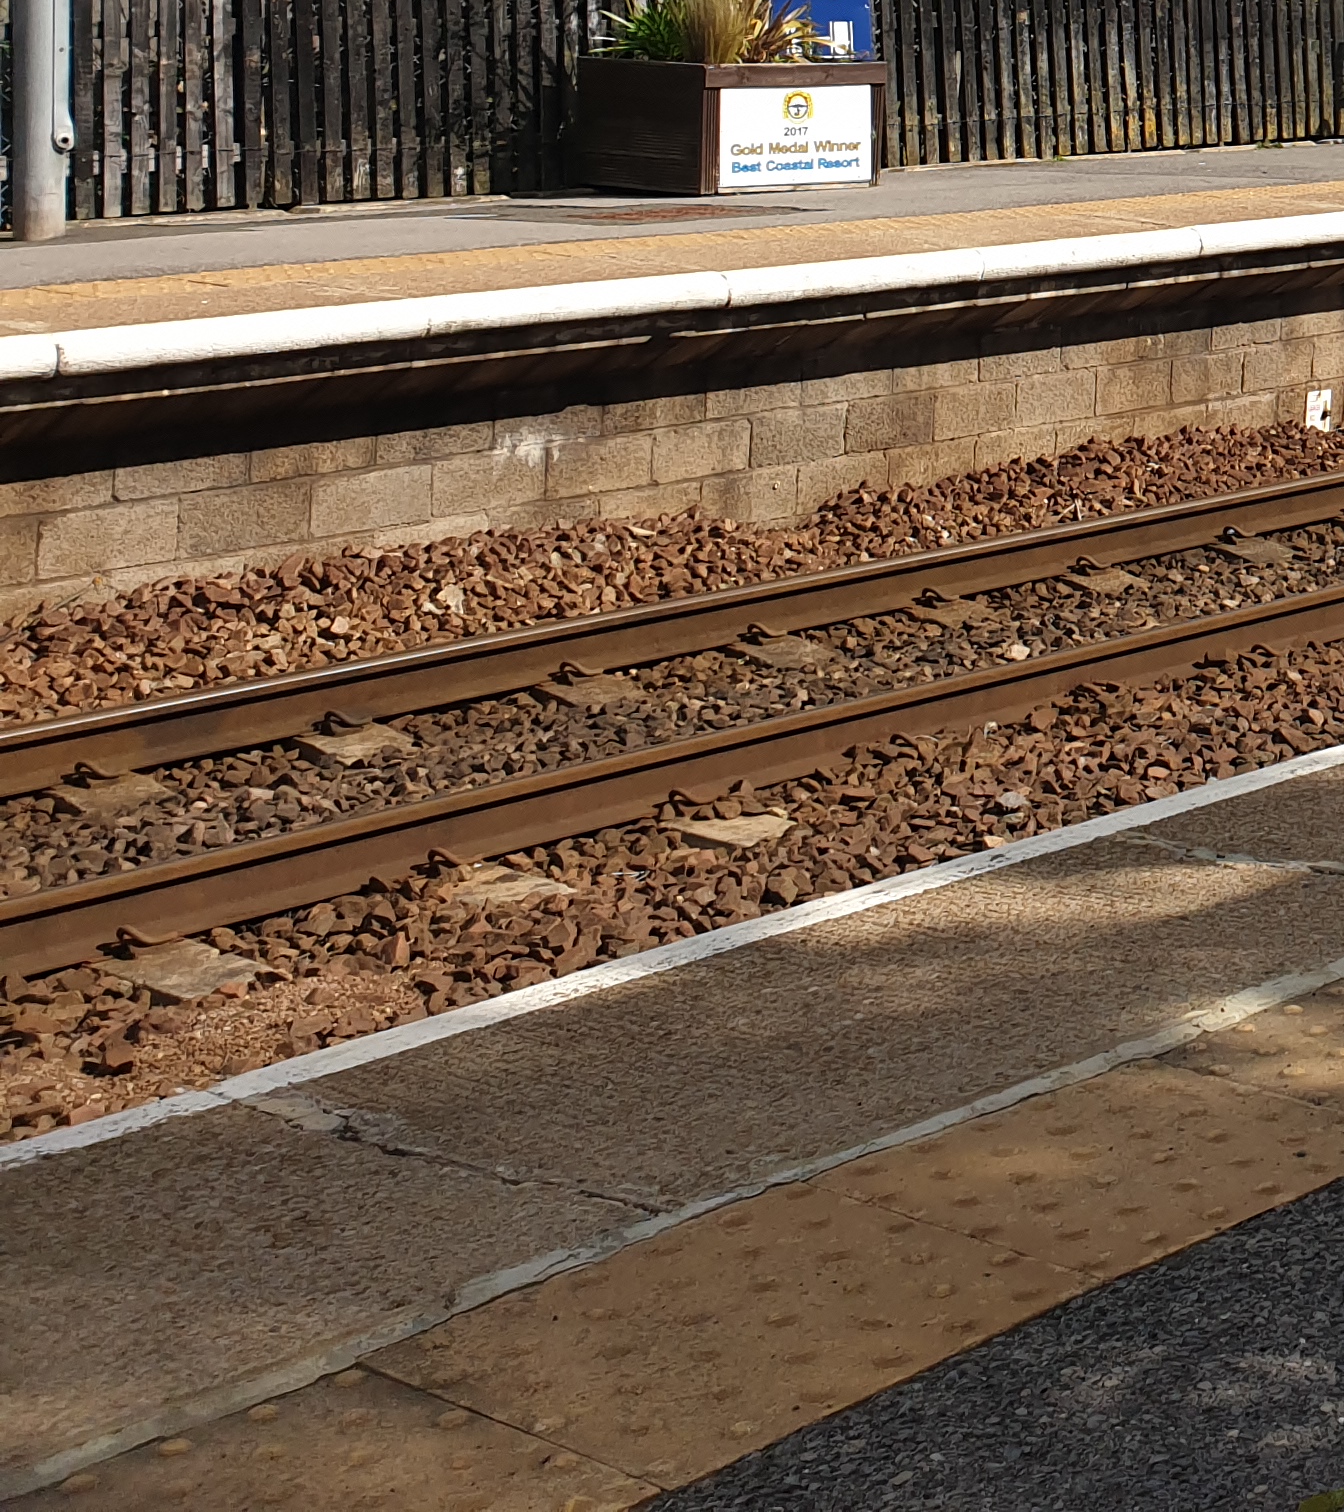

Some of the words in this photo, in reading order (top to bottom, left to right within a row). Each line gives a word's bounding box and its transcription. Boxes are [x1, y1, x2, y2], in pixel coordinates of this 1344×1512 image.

[783, 126, 809, 136] 2017
[730, 143, 764, 156] Gold
[768, 141, 809, 155] Medal
[814, 140, 861, 153] Winner
[731, 161, 762, 173] Best
[766, 158, 814, 172] Coastal
[818, 157, 860, 169] Resort
